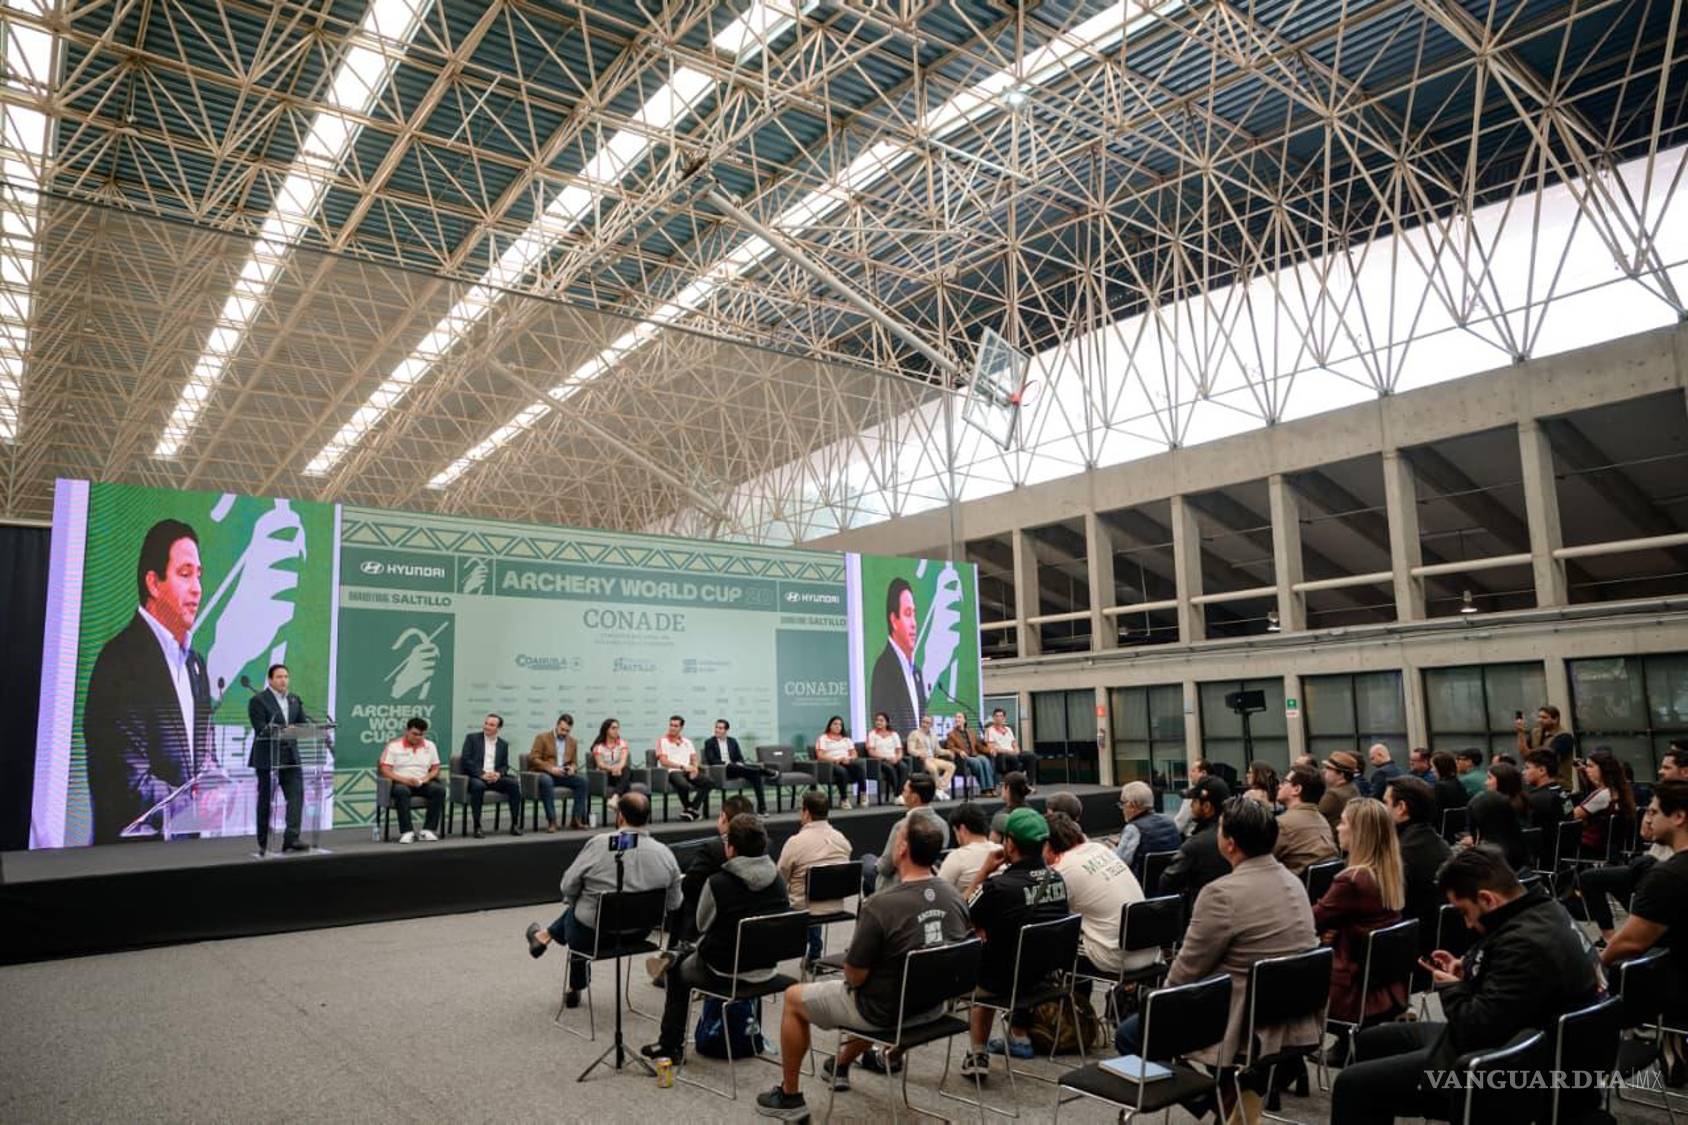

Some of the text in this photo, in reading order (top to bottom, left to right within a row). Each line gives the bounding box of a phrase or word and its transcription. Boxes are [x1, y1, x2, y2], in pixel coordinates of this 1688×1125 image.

[387, 564, 445, 578] HYUNDAI
[502, 571, 617, 596] ARCHERY
[621, 579, 698, 601] WORLD
[701, 584, 742, 602] CUP
[392, 594, 452, 607] SALTILLO
[801, 594, 840, 604] HYUNDAI
[583, 608, 686, 632] CONADE
[810, 617, 847, 627] SALTILLO
[784, 681, 849, 696] CONADE
[351, 704, 435, 718] ARCHERY
[369, 717, 432, 731] WOR
